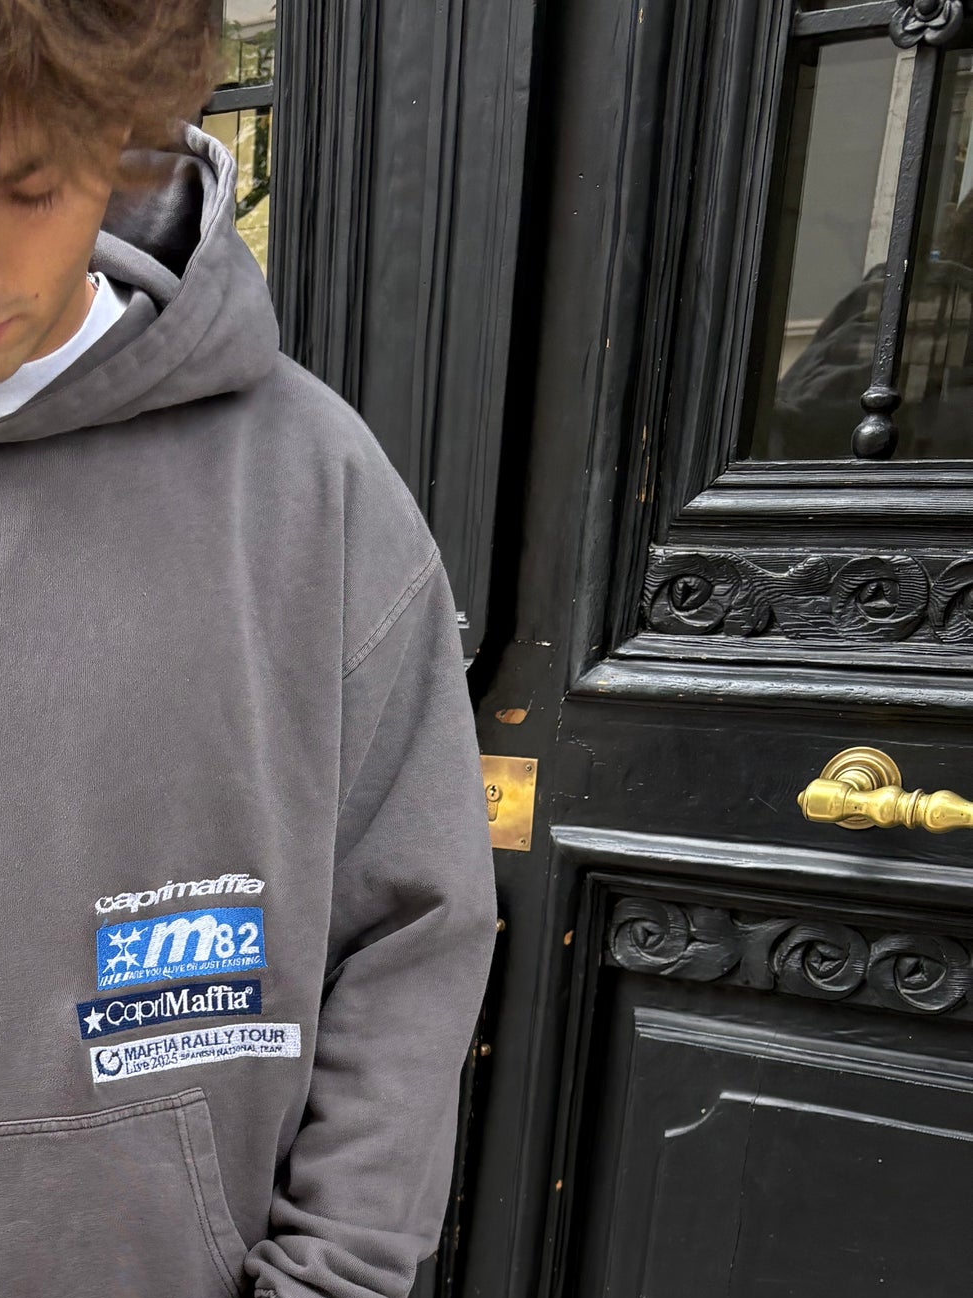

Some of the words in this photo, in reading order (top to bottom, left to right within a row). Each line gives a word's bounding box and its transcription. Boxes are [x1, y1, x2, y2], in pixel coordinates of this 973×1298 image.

[95, 873, 266, 915] caprimaffia
[146, 967, 162, 978] YOU
[199, 960, 220, 971] JUST
[124, 1037, 179, 1061] MAFFIA
[181, 1030, 234, 1051] RALLY
[239, 1028, 285, 1043] TOUR
